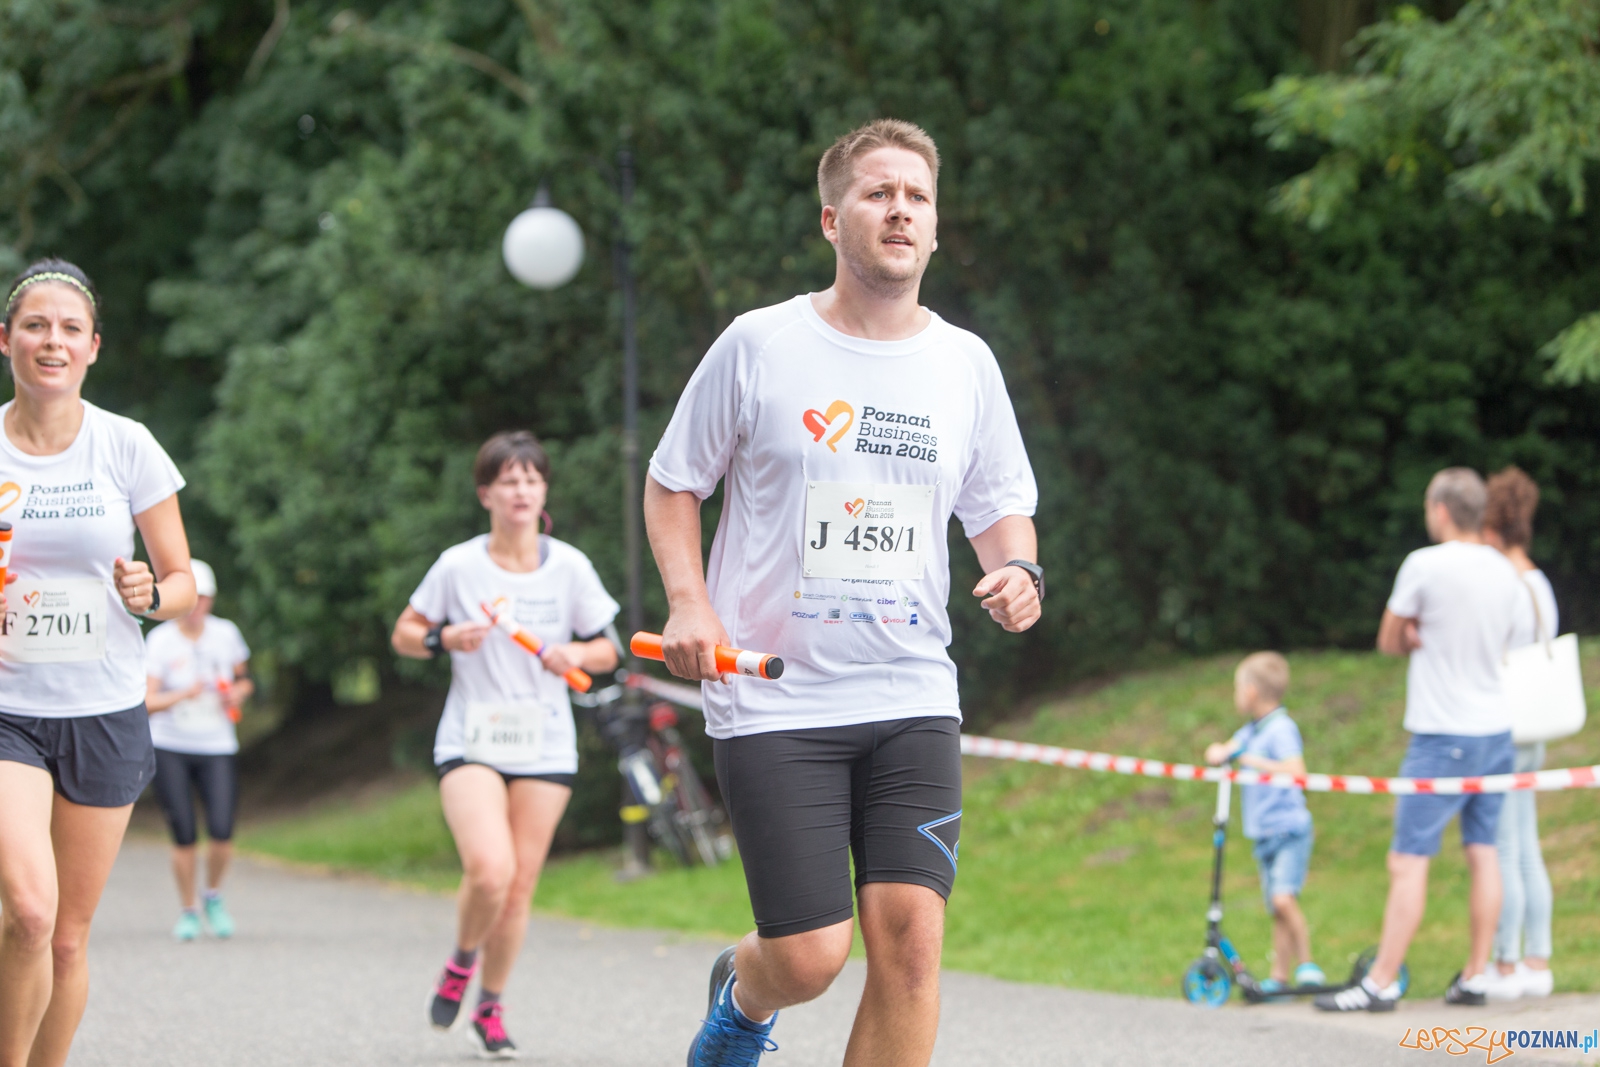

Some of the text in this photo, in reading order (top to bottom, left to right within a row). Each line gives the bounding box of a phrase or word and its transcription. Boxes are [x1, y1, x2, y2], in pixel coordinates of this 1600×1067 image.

[861, 406, 931, 429] Poznań
[858, 421, 938, 447] Business
[855, 438, 938, 463] Run 2016
[29, 478, 94, 494] Poznań
[26, 494, 103, 507] Business
[867, 499, 892, 507] Poznań
[21, 505, 105, 519] Run 2016
[810, 521, 832, 550] J
[844, 525, 915, 553] 458/1
[877, 597, 897, 605] ciber
[1, 611, 18, 636] F
[26, 612, 92, 636] 270/1
